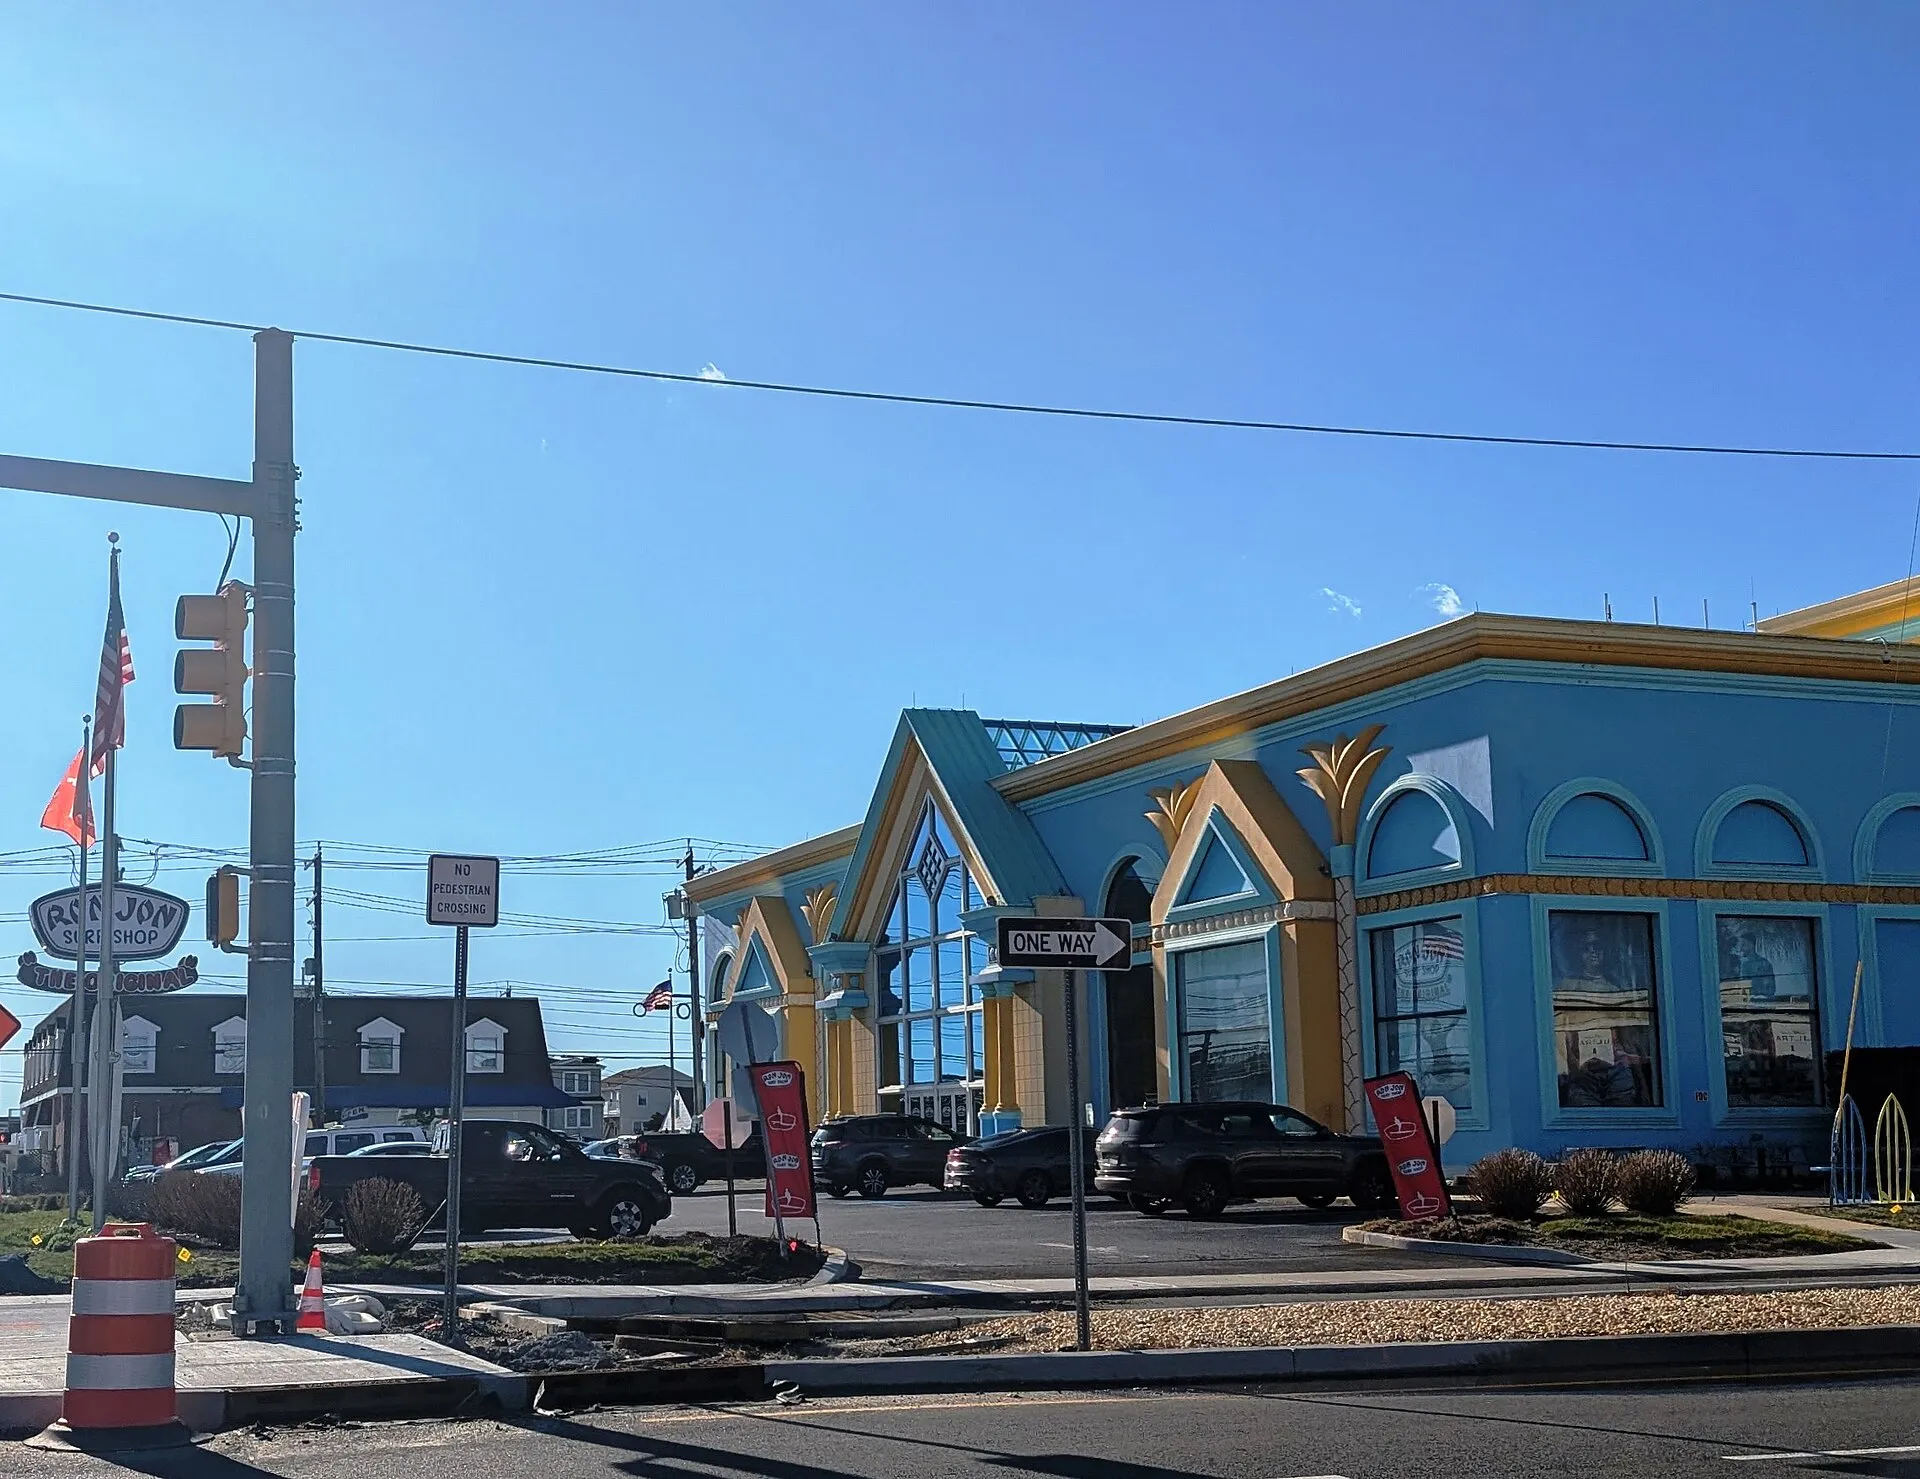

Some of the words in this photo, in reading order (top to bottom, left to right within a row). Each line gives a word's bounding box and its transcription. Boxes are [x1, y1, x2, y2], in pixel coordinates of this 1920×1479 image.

[454, 864, 471, 876] NO
[433, 884, 491, 896] PEDESTRIAN
[115, 896, 178, 930] JON
[437, 902, 487, 914] CROSSING
[113, 929, 159, 945] SHOP
[1013, 932, 1052, 953] ONE
[1057, 933, 1096, 953] WAY
